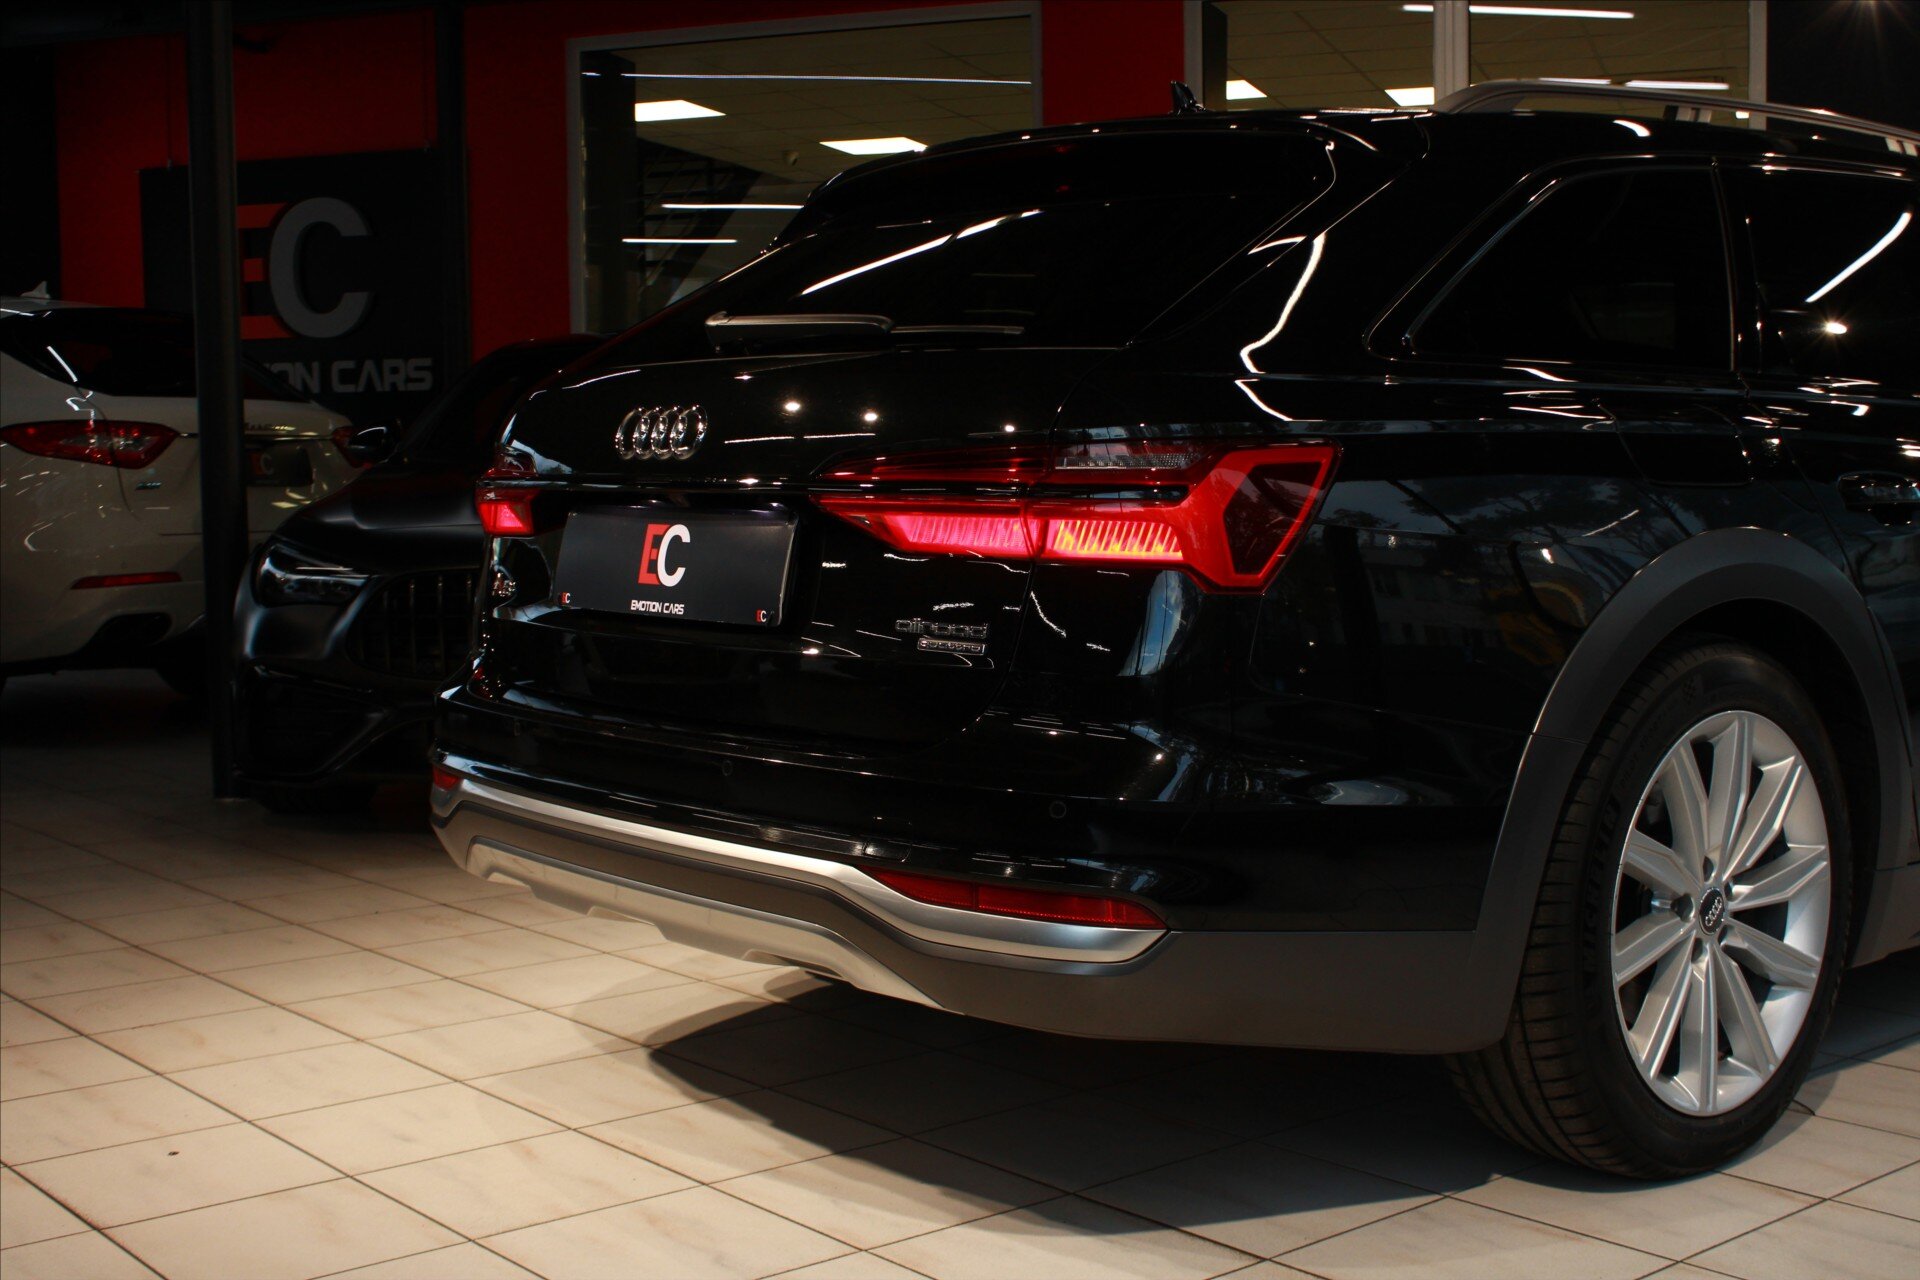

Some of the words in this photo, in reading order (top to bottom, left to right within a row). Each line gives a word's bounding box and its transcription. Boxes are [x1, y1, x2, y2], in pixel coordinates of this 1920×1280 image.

[330, 356, 434, 393] CARS
[637, 523, 691, 587] EC
[630, 599, 663, 613] EMOTION
[663, 602, 685, 615] CARS
